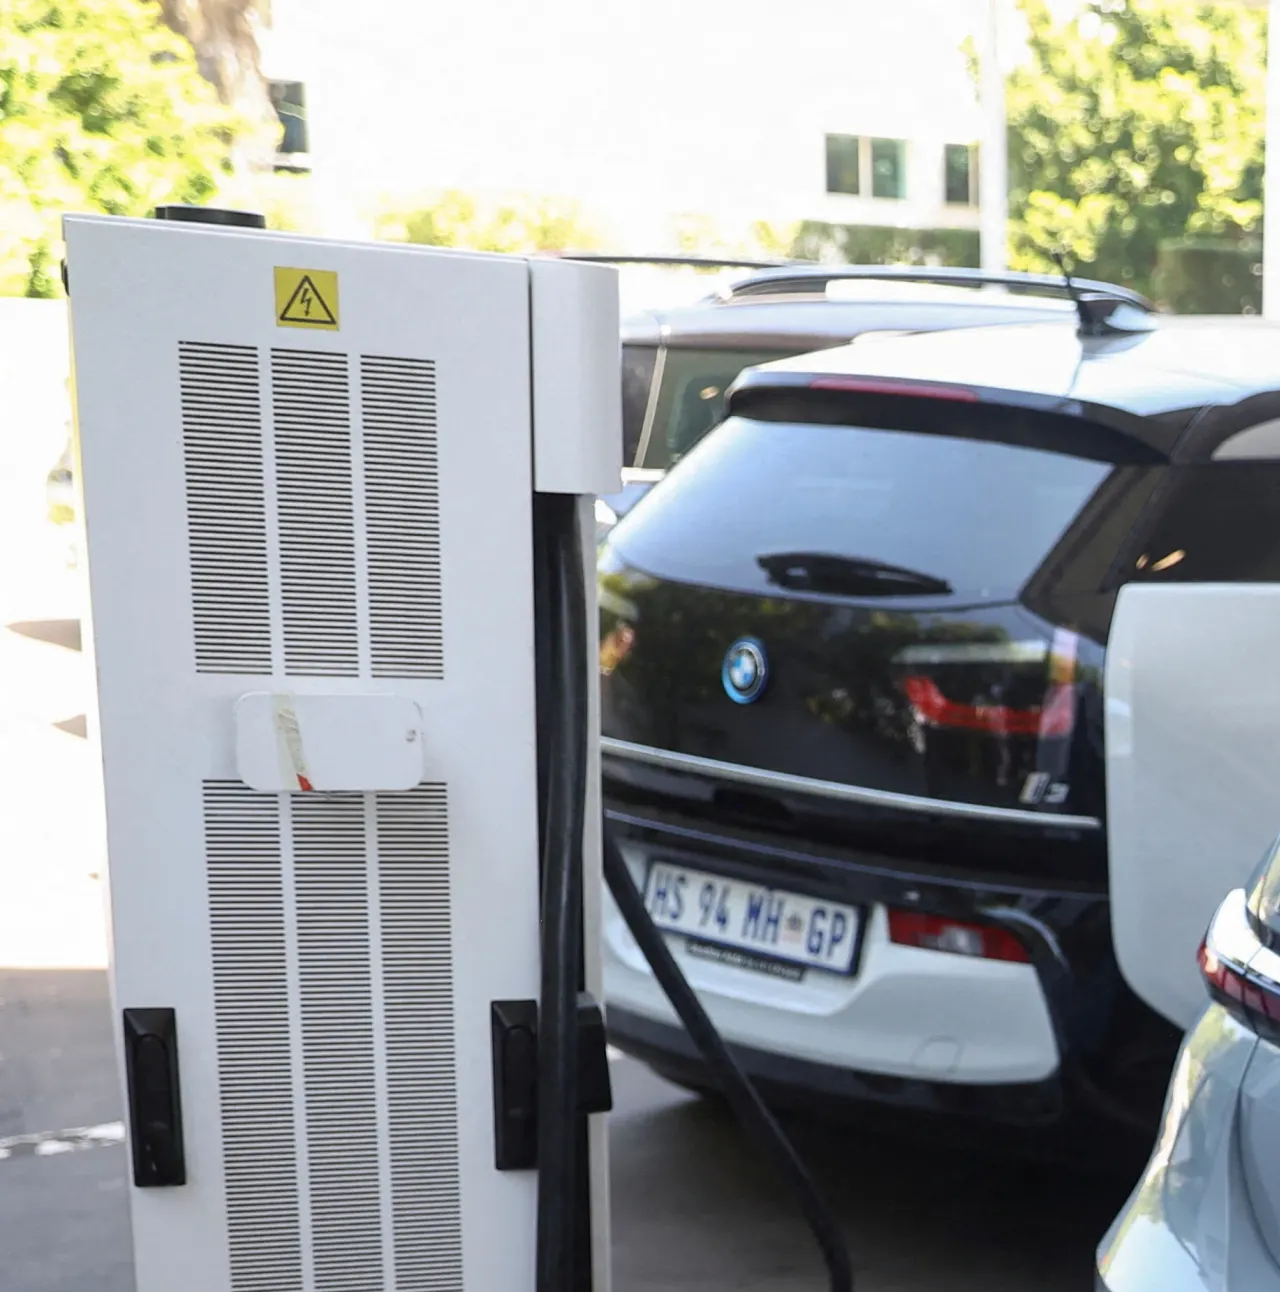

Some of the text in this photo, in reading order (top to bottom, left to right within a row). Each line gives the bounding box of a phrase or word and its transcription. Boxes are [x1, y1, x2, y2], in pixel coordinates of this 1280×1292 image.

[651, 869, 848, 959] HS 94 MH GP
